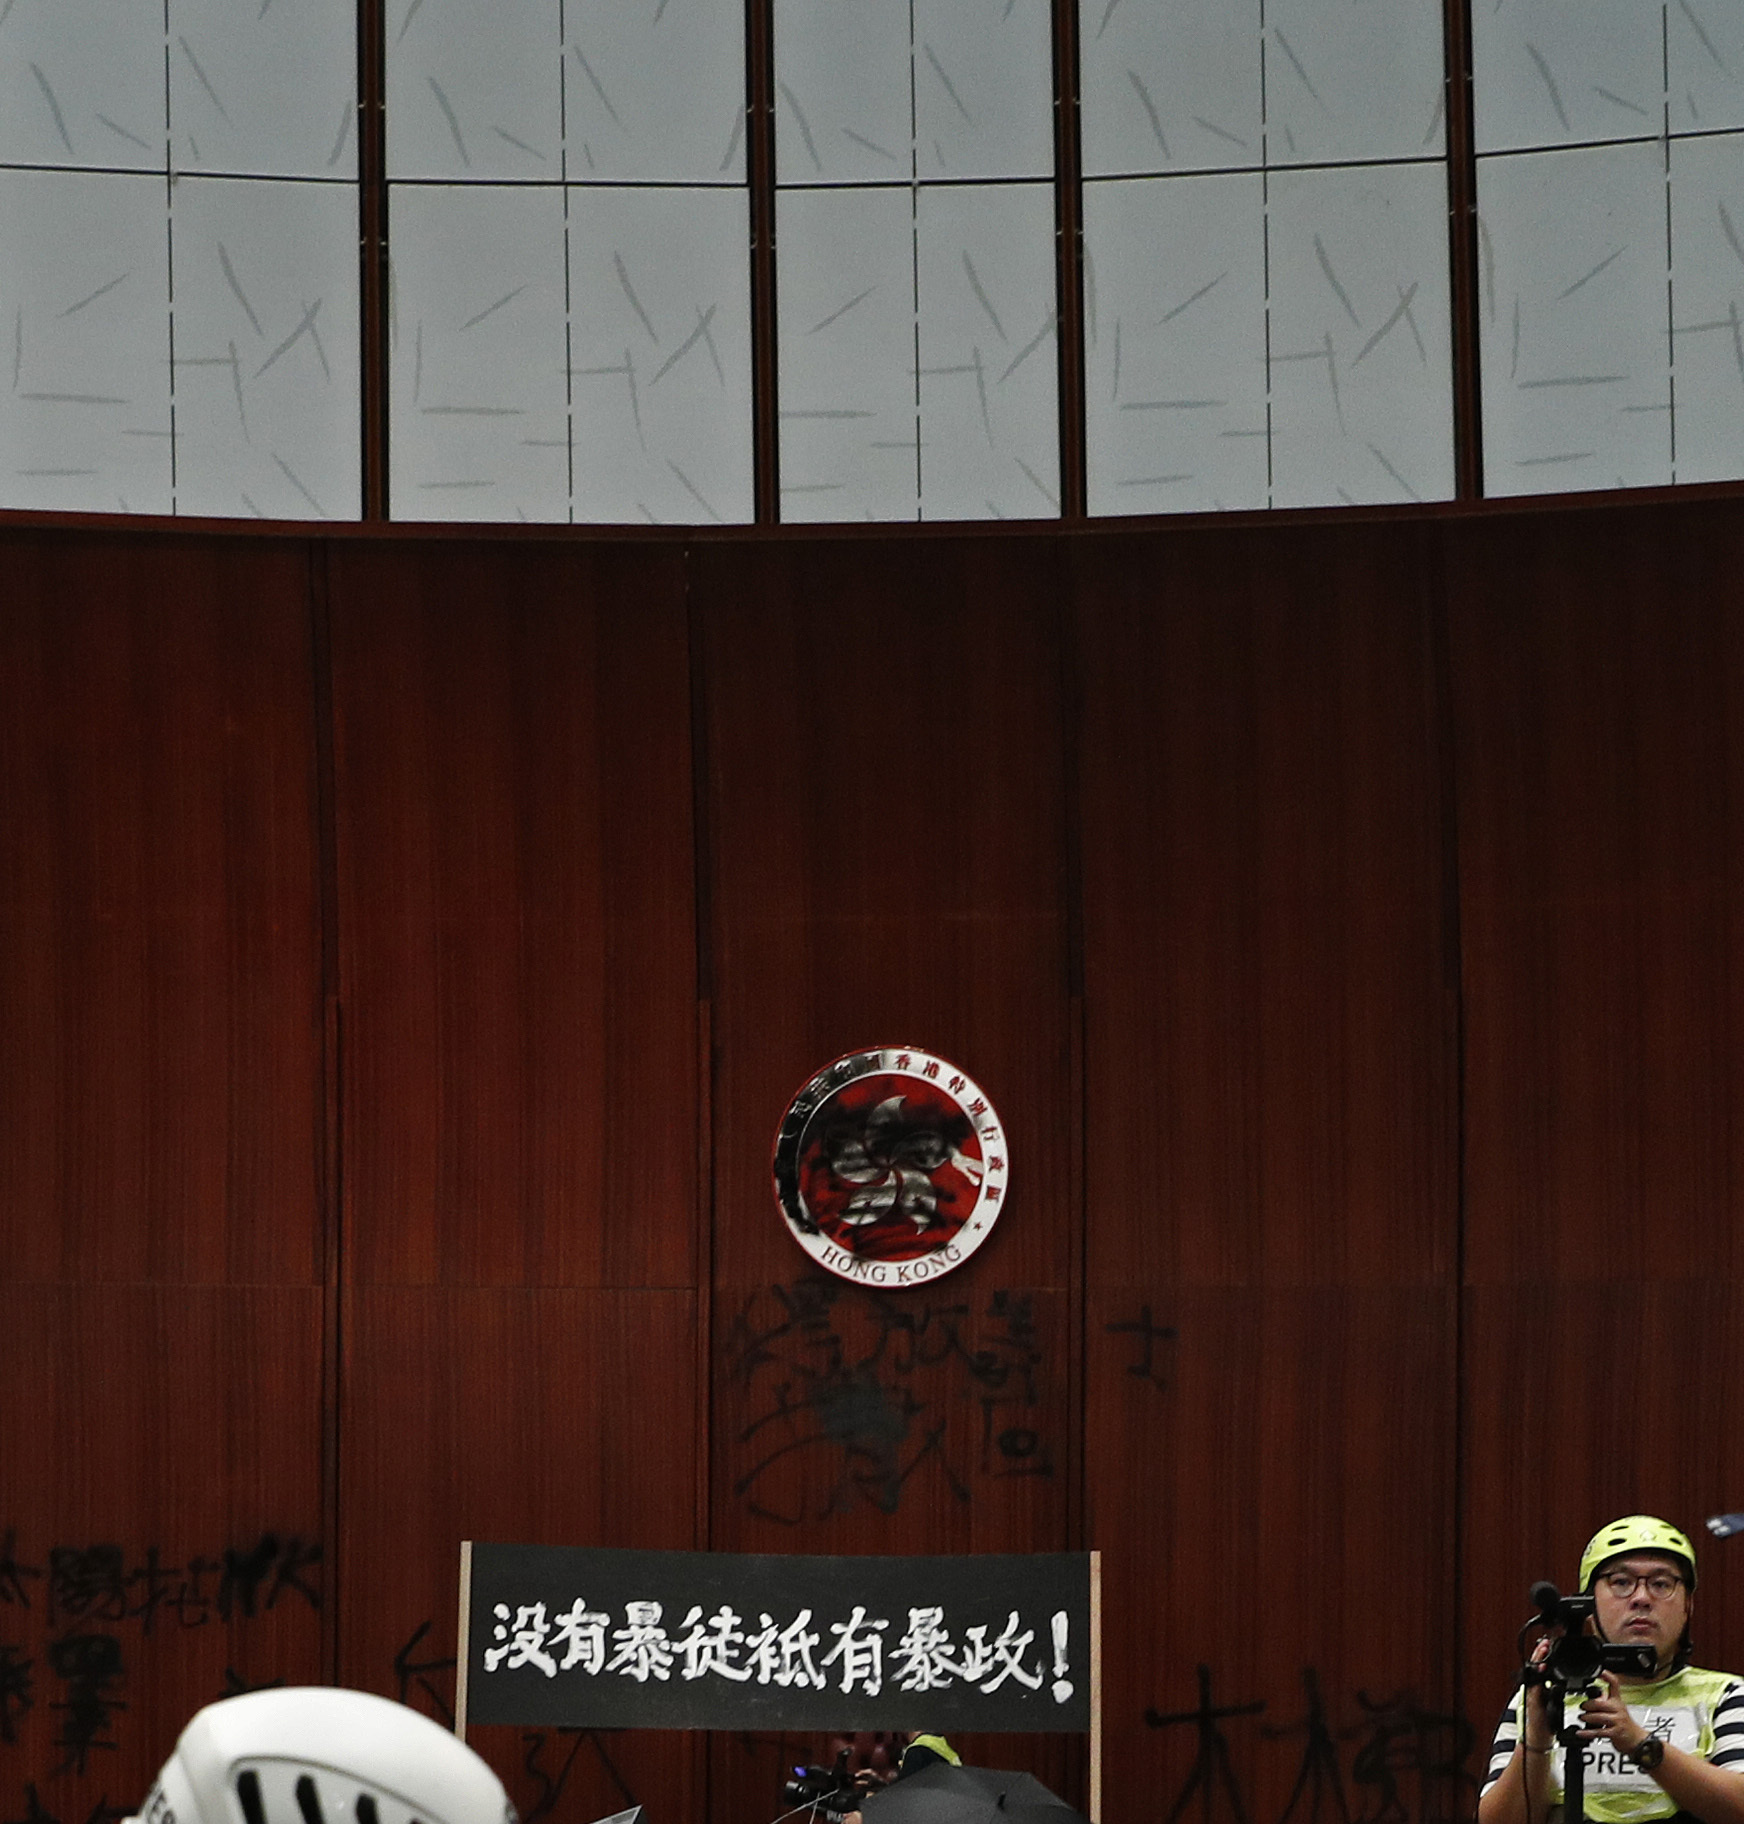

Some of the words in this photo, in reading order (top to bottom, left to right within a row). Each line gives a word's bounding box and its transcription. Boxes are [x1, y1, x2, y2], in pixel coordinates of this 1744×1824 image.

[821, 1245, 886, 1283] HONG
[896, 1243, 962, 1283] KONG
[1582, 1752, 1650, 1776] PRE
